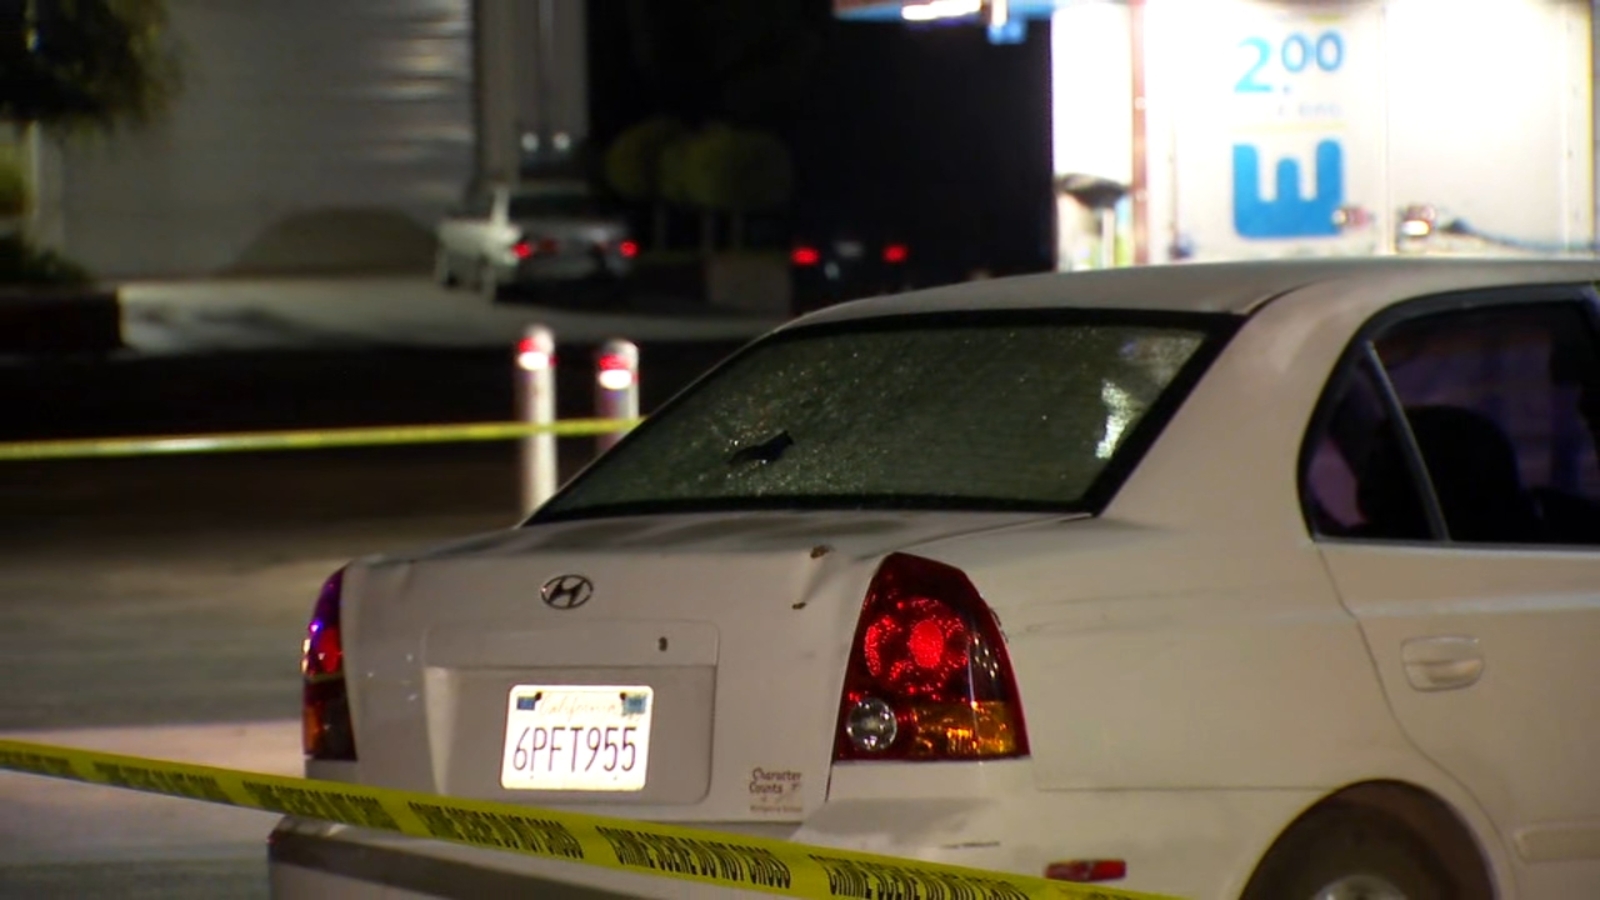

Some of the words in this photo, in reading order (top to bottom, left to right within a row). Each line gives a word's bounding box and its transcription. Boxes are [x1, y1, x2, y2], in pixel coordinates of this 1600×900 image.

[512, 726, 637, 772] 6PFT955
[752, 766, 802, 781] Character
[749, 781, 783, 794] Counts
